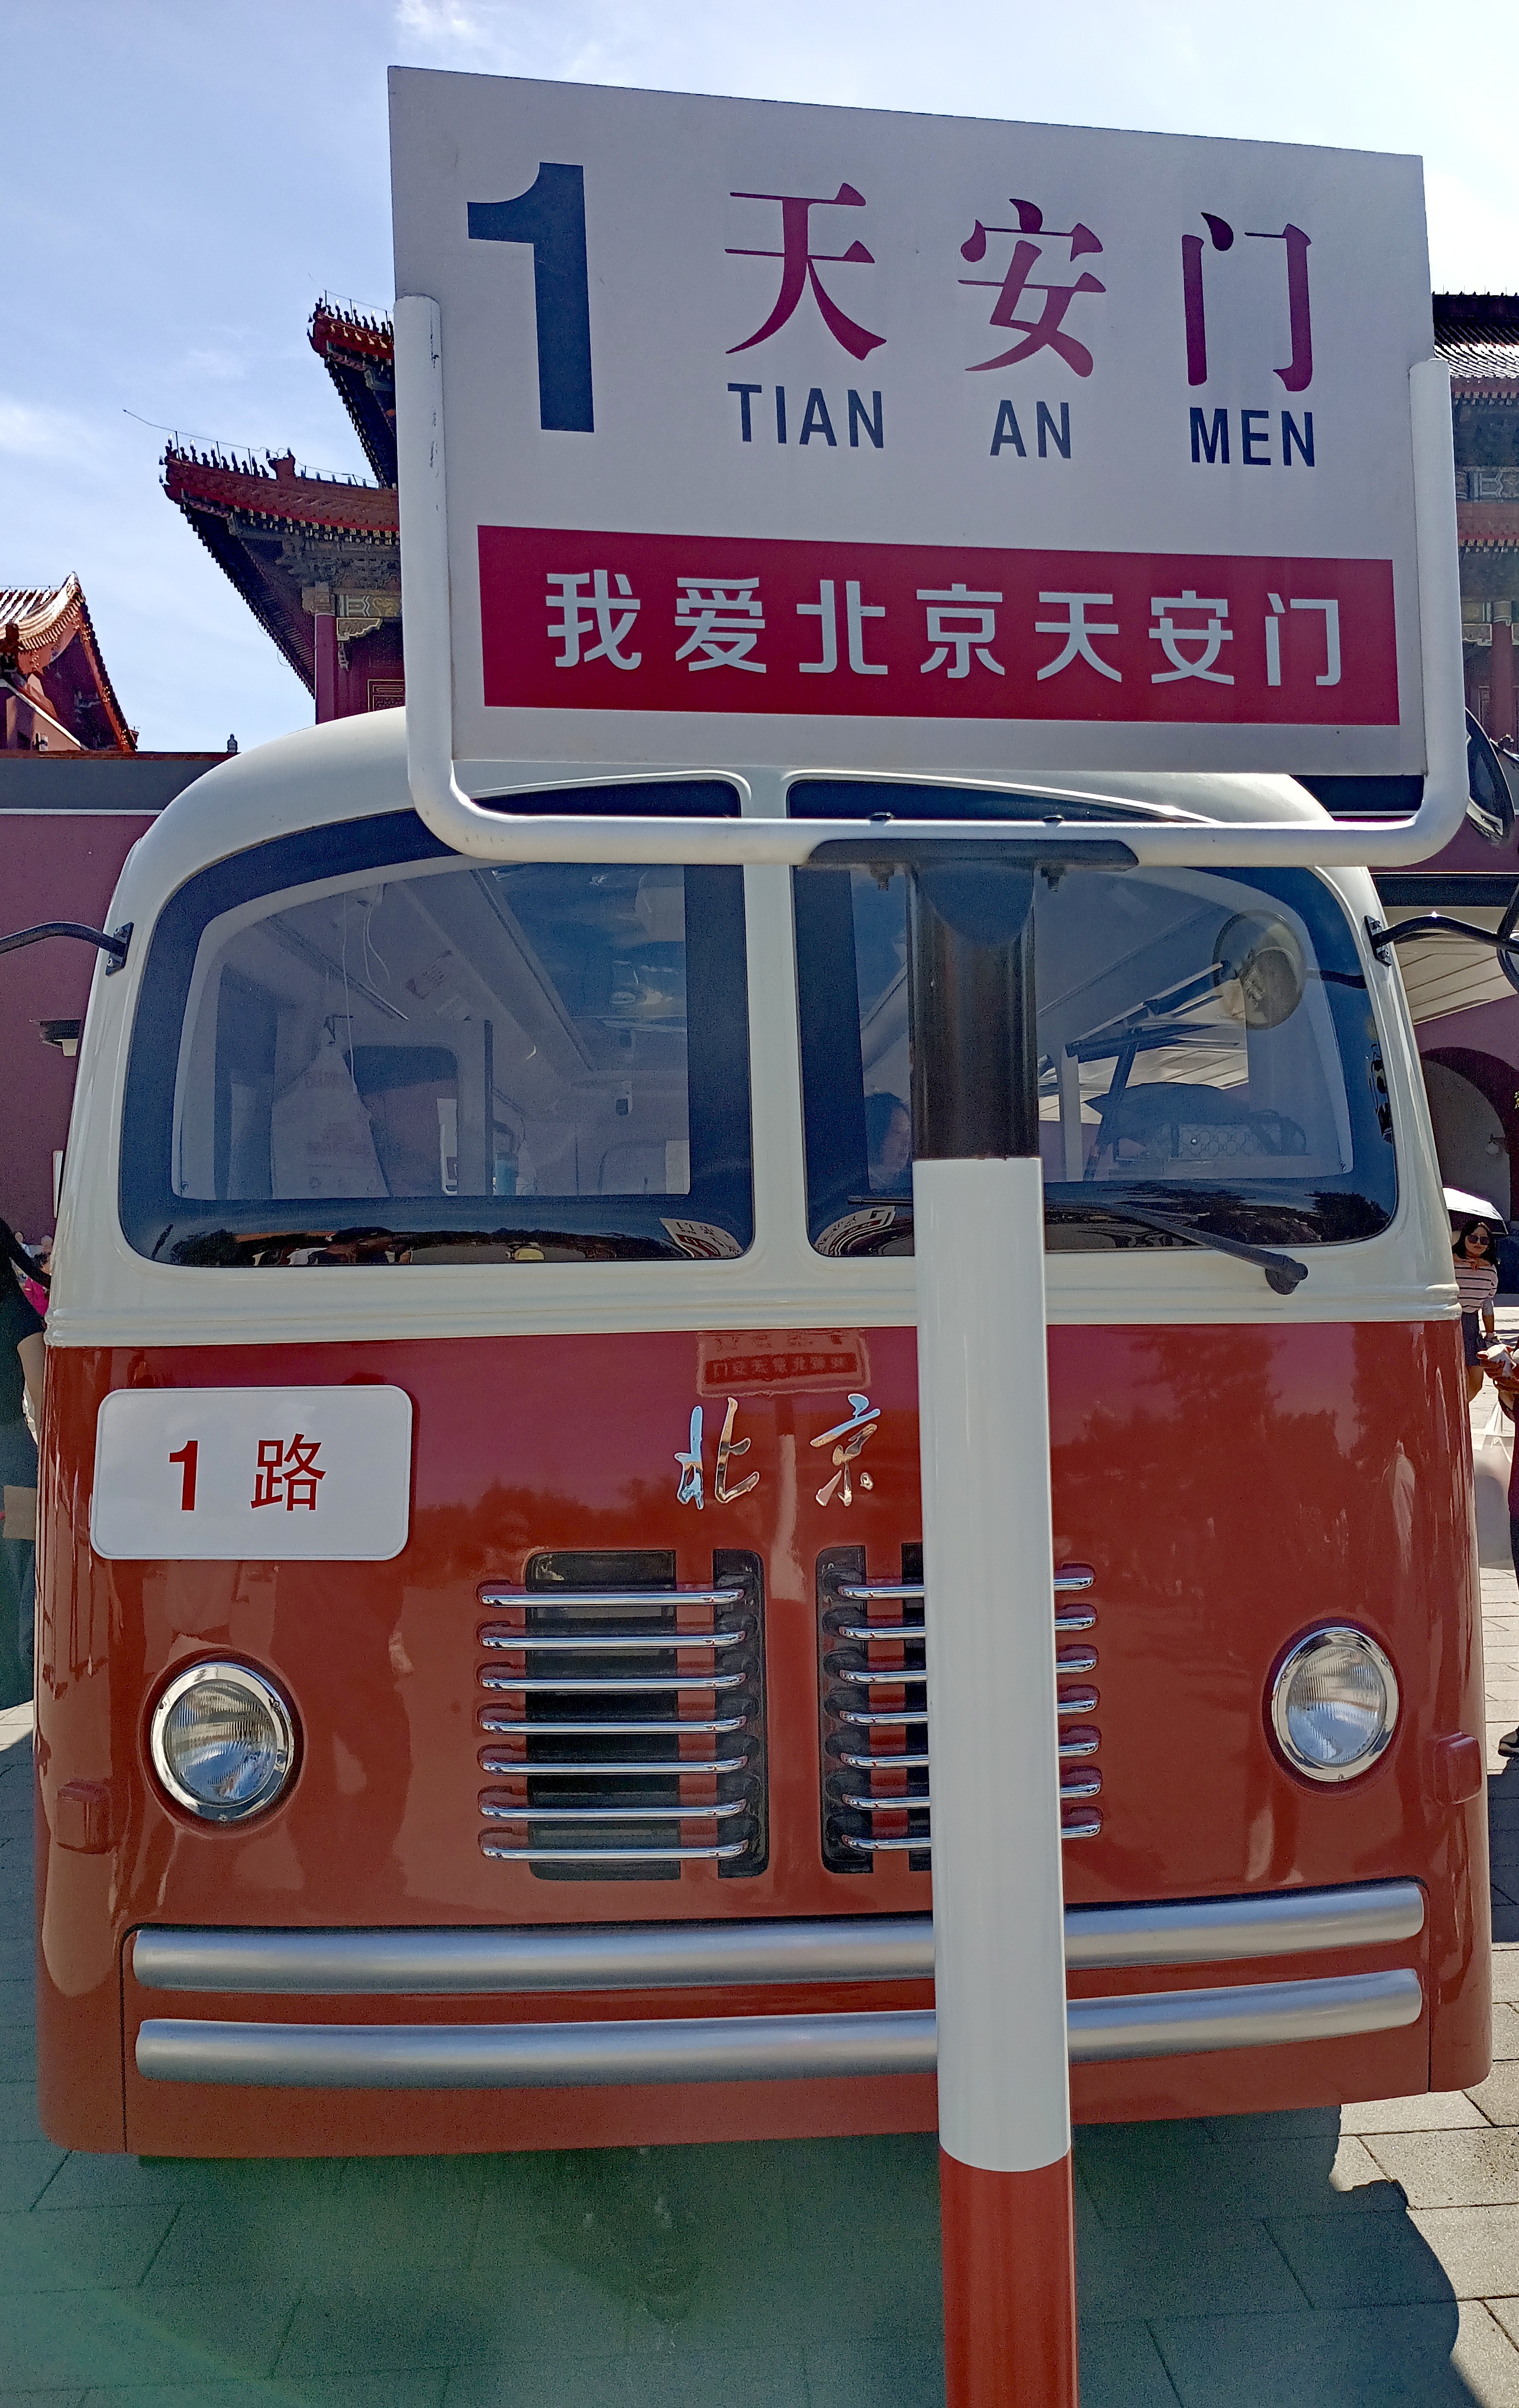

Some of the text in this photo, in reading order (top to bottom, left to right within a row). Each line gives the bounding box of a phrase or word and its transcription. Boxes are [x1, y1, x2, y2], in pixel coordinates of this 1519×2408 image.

[467, 162, 594, 432] 1
[725, 183, 1312, 392] 天安门
[727, 382, 1315, 467] TIAN AN MEN
[546, 569, 1341, 686] 我爱北京天安门
[674, 1393, 881, 1510] 北京
